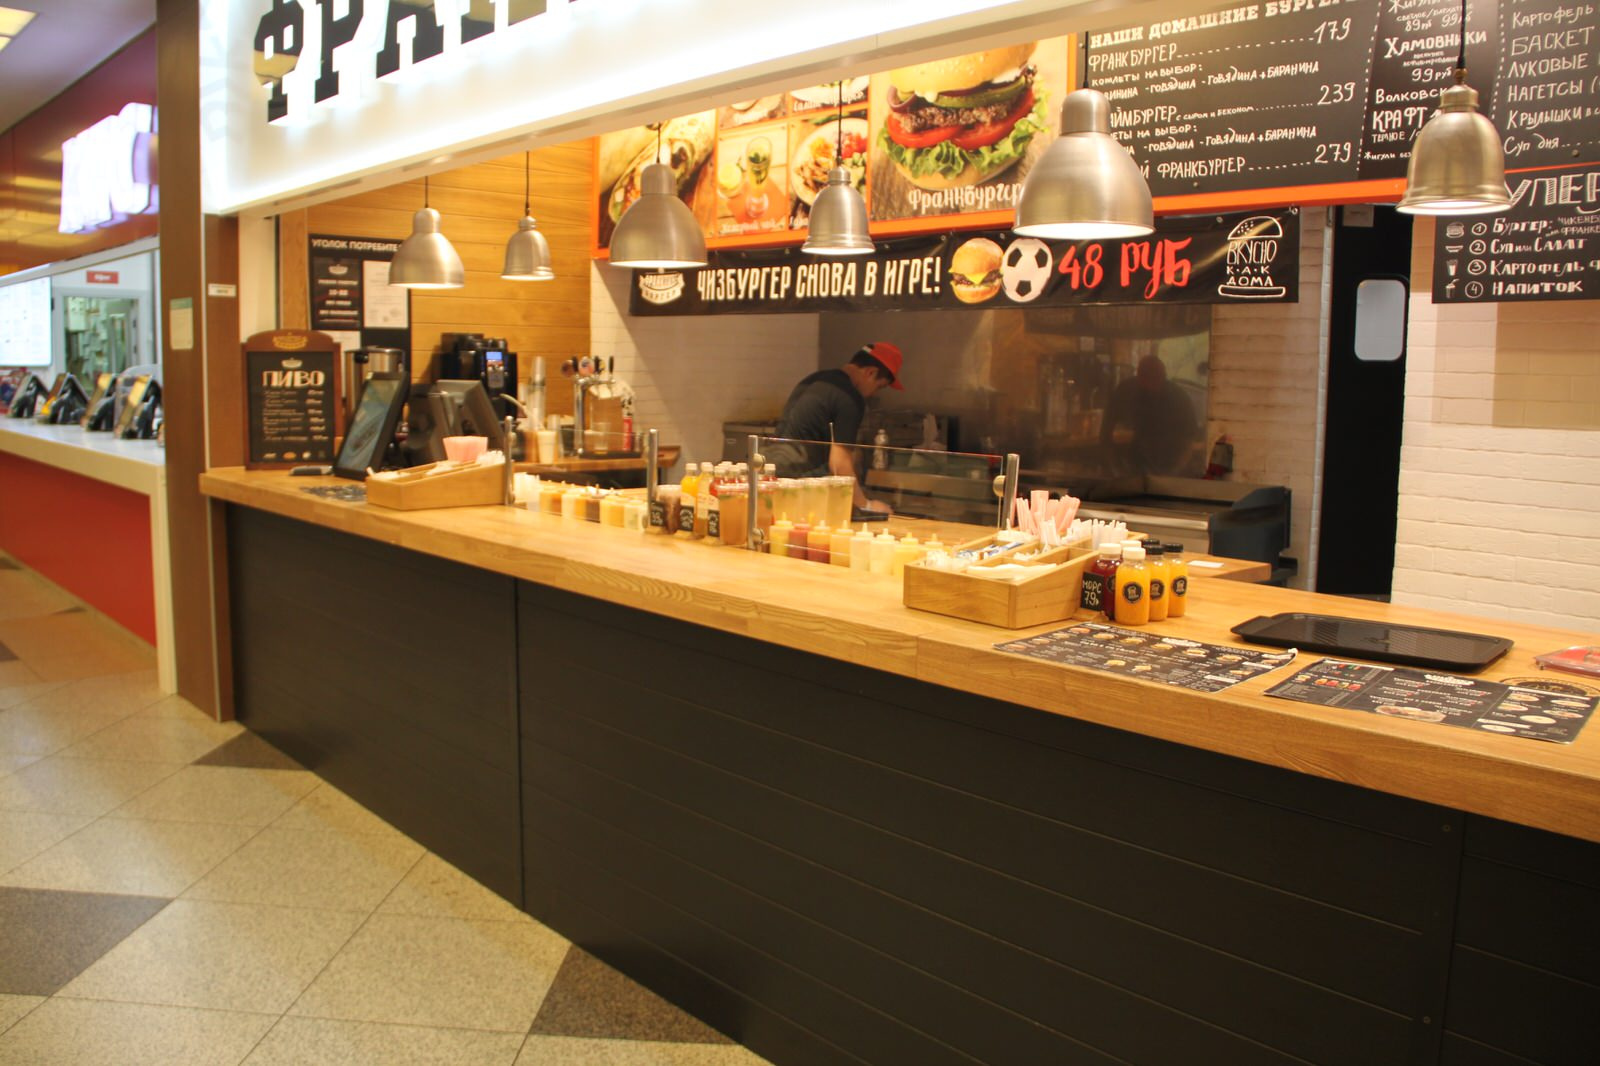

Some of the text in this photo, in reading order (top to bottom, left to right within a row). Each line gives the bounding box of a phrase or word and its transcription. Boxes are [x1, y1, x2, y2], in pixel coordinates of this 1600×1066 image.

[1090, 26, 1143, 49] НАШИ
[1148, 5, 1259, 40] ДОМАШНИЕ
[1313, 18, 1352, 44] 179
[1511, 25, 1596, 57] БАСКЕТ
[1507, 52, 1589, 79] ЛУКОВЫЕ
[1316, 82, 1356, 105] 239
[1507, 79, 1584, 103] НАГЕТСЫ
[1371, 106, 1428, 133] КРАФТ
[1156, 155, 1246, 180] ФРАНКБУРГЕР
[1313, 141, 1352, 164] 279
[311, 238, 402, 252] УГОЛОК ПОТРЕБИТЕ
[1226, 239, 1278, 266] ВКУСНО
[697, 265, 792, 301] ЧИЗБУРГЕР
[795, 261, 858, 299] СНОВА
[863, 260, 879, 297] В
[883, 255, 942, 296] ИГРЕ!
[1057, 243, 1104, 291] 48
[1225, 275, 1274, 287] ДОМА
[262, 370, 326, 388] ПИВО
[1082, 579, 1102, 594] МОРС
